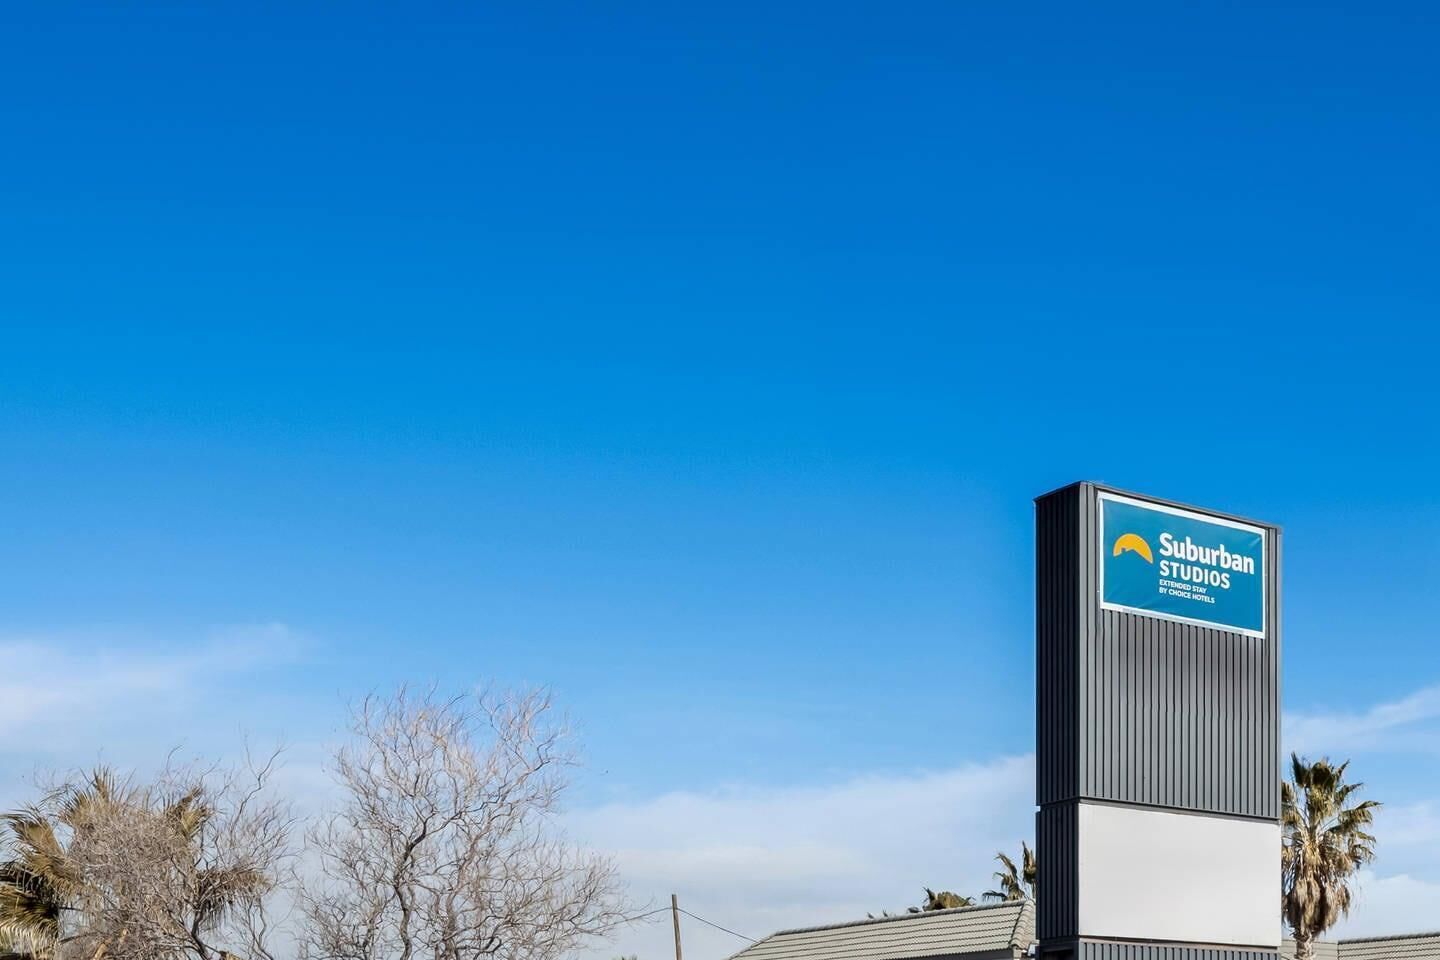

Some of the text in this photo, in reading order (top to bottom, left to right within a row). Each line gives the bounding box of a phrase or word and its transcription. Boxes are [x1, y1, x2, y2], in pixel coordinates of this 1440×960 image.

[1159, 532, 1255, 575] Suburban
[1159, 560, 1231, 589] STUDIOS
[1159, 579, 1207, 594] EXTENDED STAY
[1168, 589, 1191, 599] CHOICE
[1192, 593, 1215, 604] HOTELS
